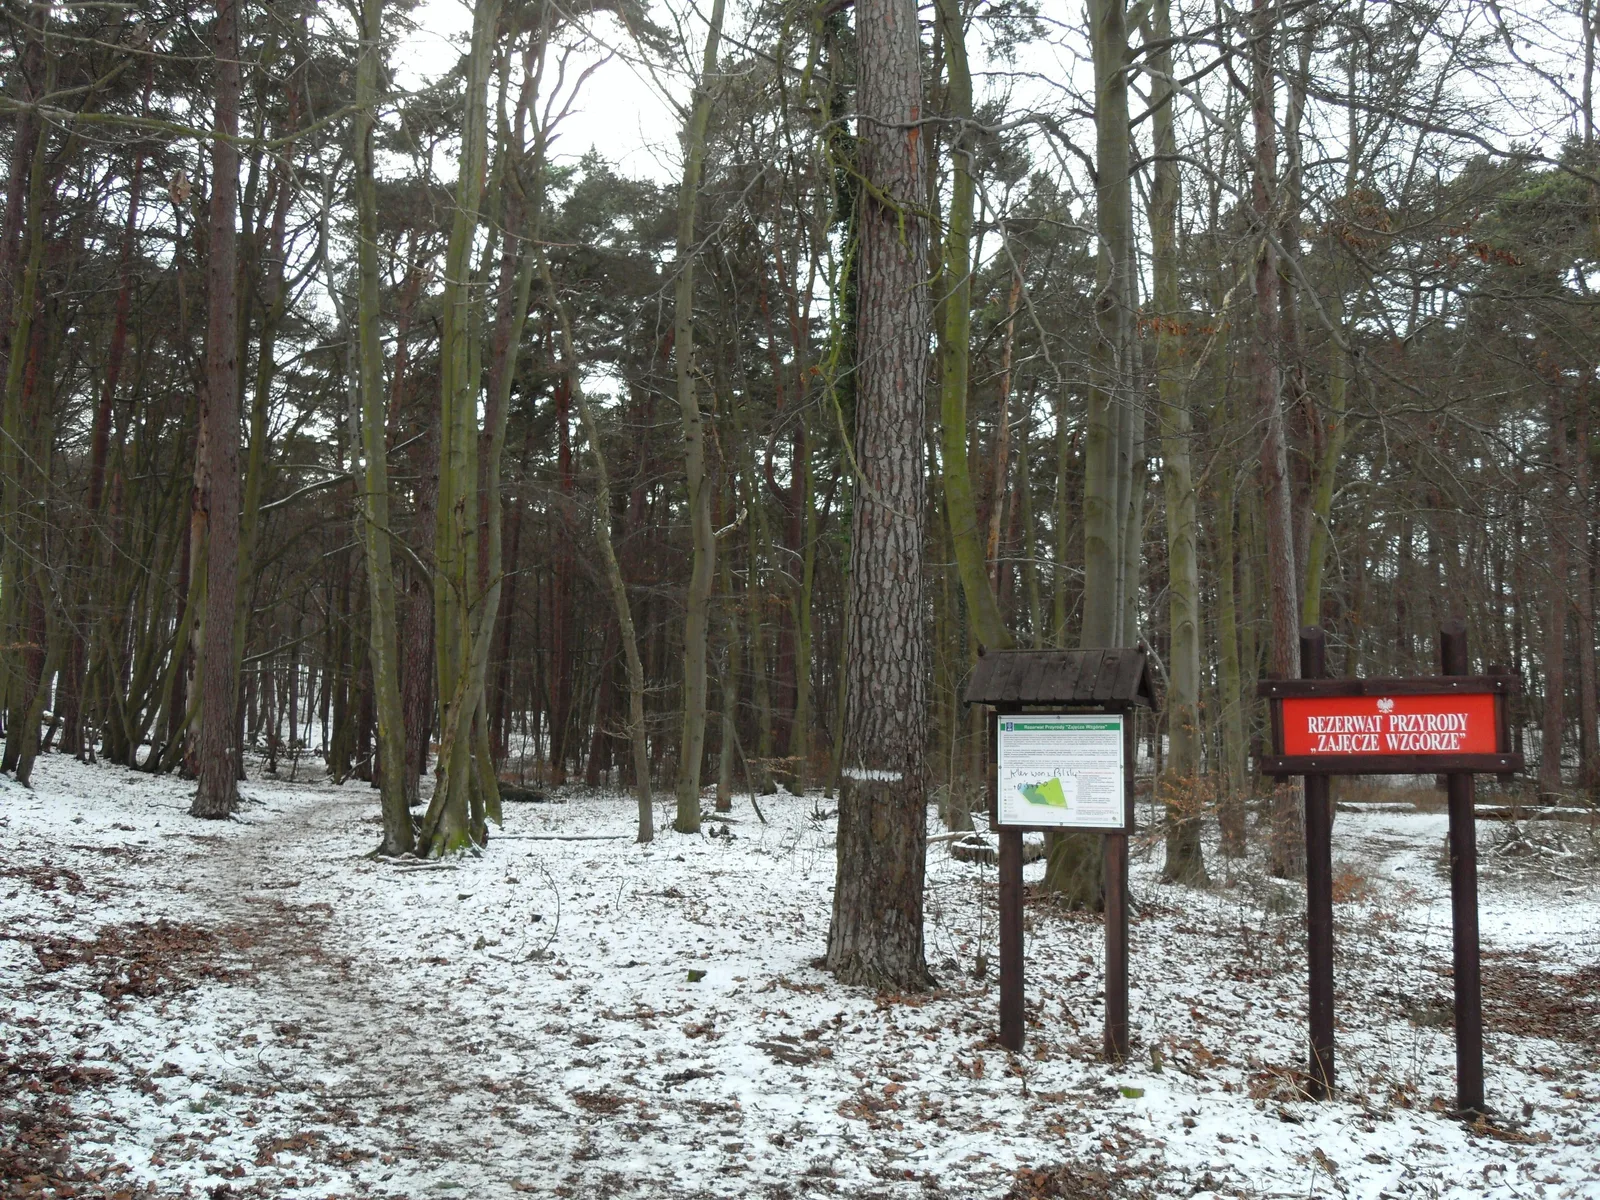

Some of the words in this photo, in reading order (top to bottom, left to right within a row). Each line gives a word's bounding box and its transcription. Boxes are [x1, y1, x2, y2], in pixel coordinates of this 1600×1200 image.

[1307, 715, 1383, 734] REZERWAT
[1389, 713, 1469, 733] PRZYRODY
[1310, 734, 1380, 754] „ZAJĘCZE
[1385, 731, 1466, 751] WZGÓRZE”
